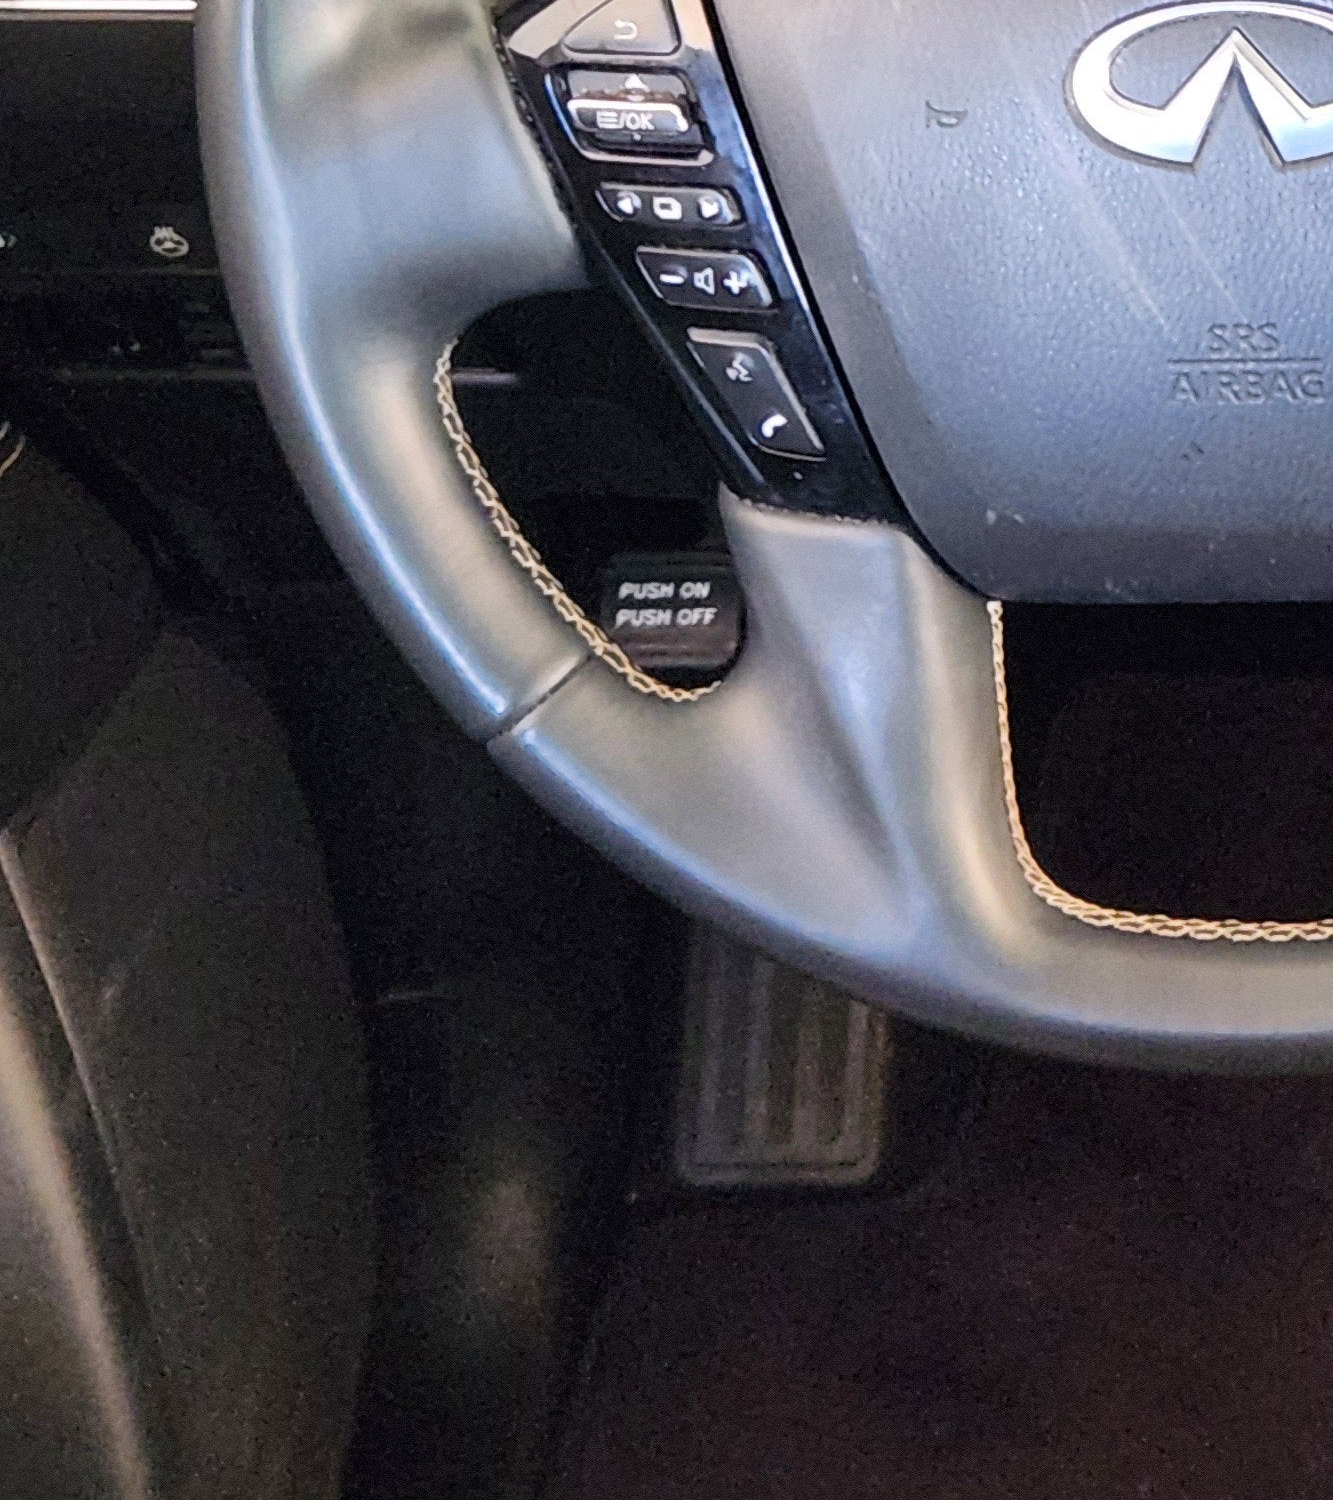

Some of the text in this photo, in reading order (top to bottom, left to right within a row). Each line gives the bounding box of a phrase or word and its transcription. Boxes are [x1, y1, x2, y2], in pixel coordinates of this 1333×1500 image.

[1206, 322, 1280, 355] SRS
[1168, 368, 1327, 405] AIRBAG
[618, 581, 711, 600] PUSH ON
[614, 607, 718, 629] PUSH OFF
